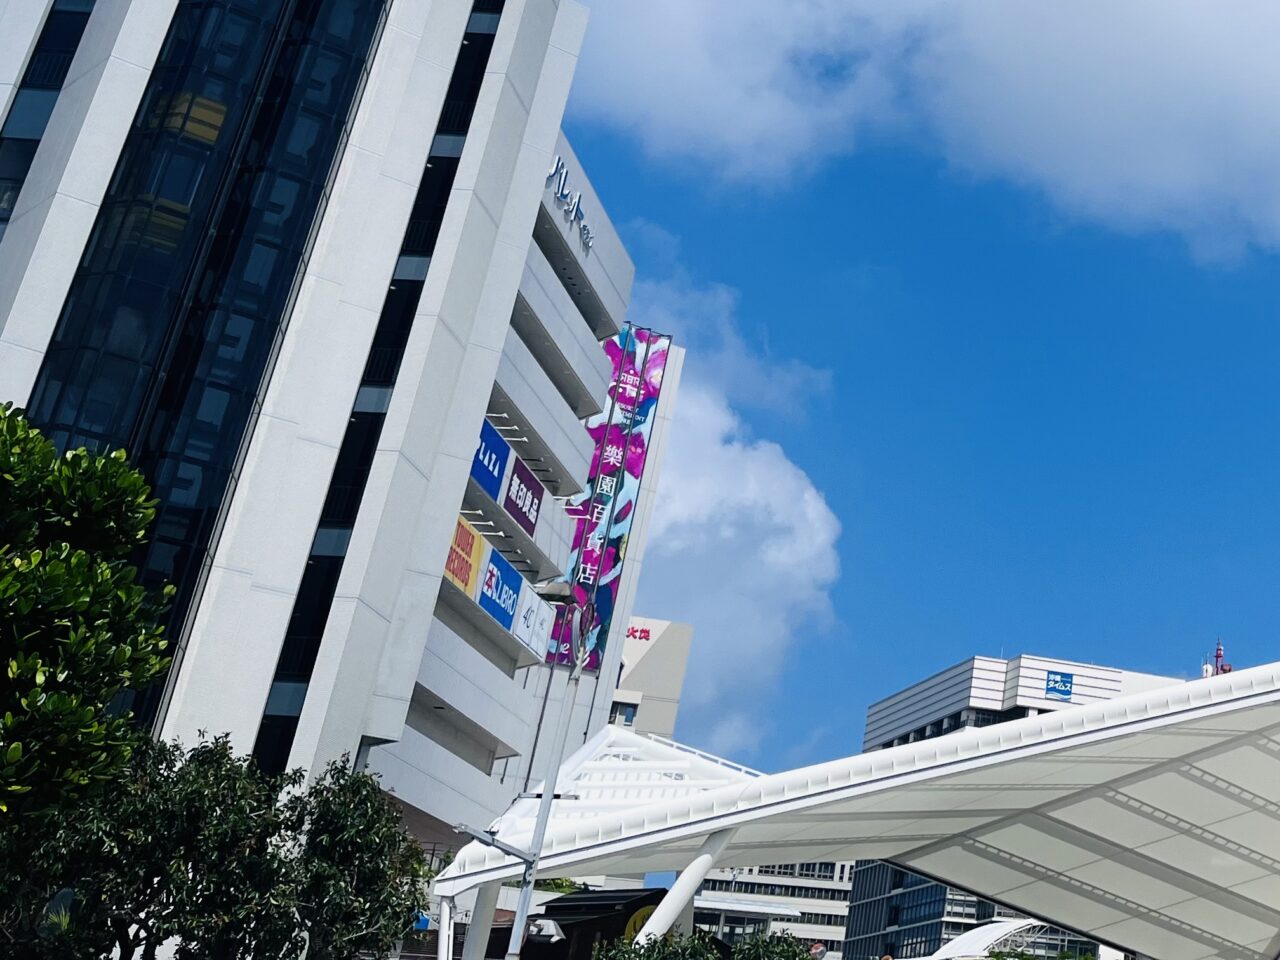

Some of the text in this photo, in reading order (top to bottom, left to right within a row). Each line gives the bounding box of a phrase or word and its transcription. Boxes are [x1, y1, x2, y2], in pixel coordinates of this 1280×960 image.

[508, 473, 539, 525] 無印良品
[1047, 680, 1072, 691] タイムス
